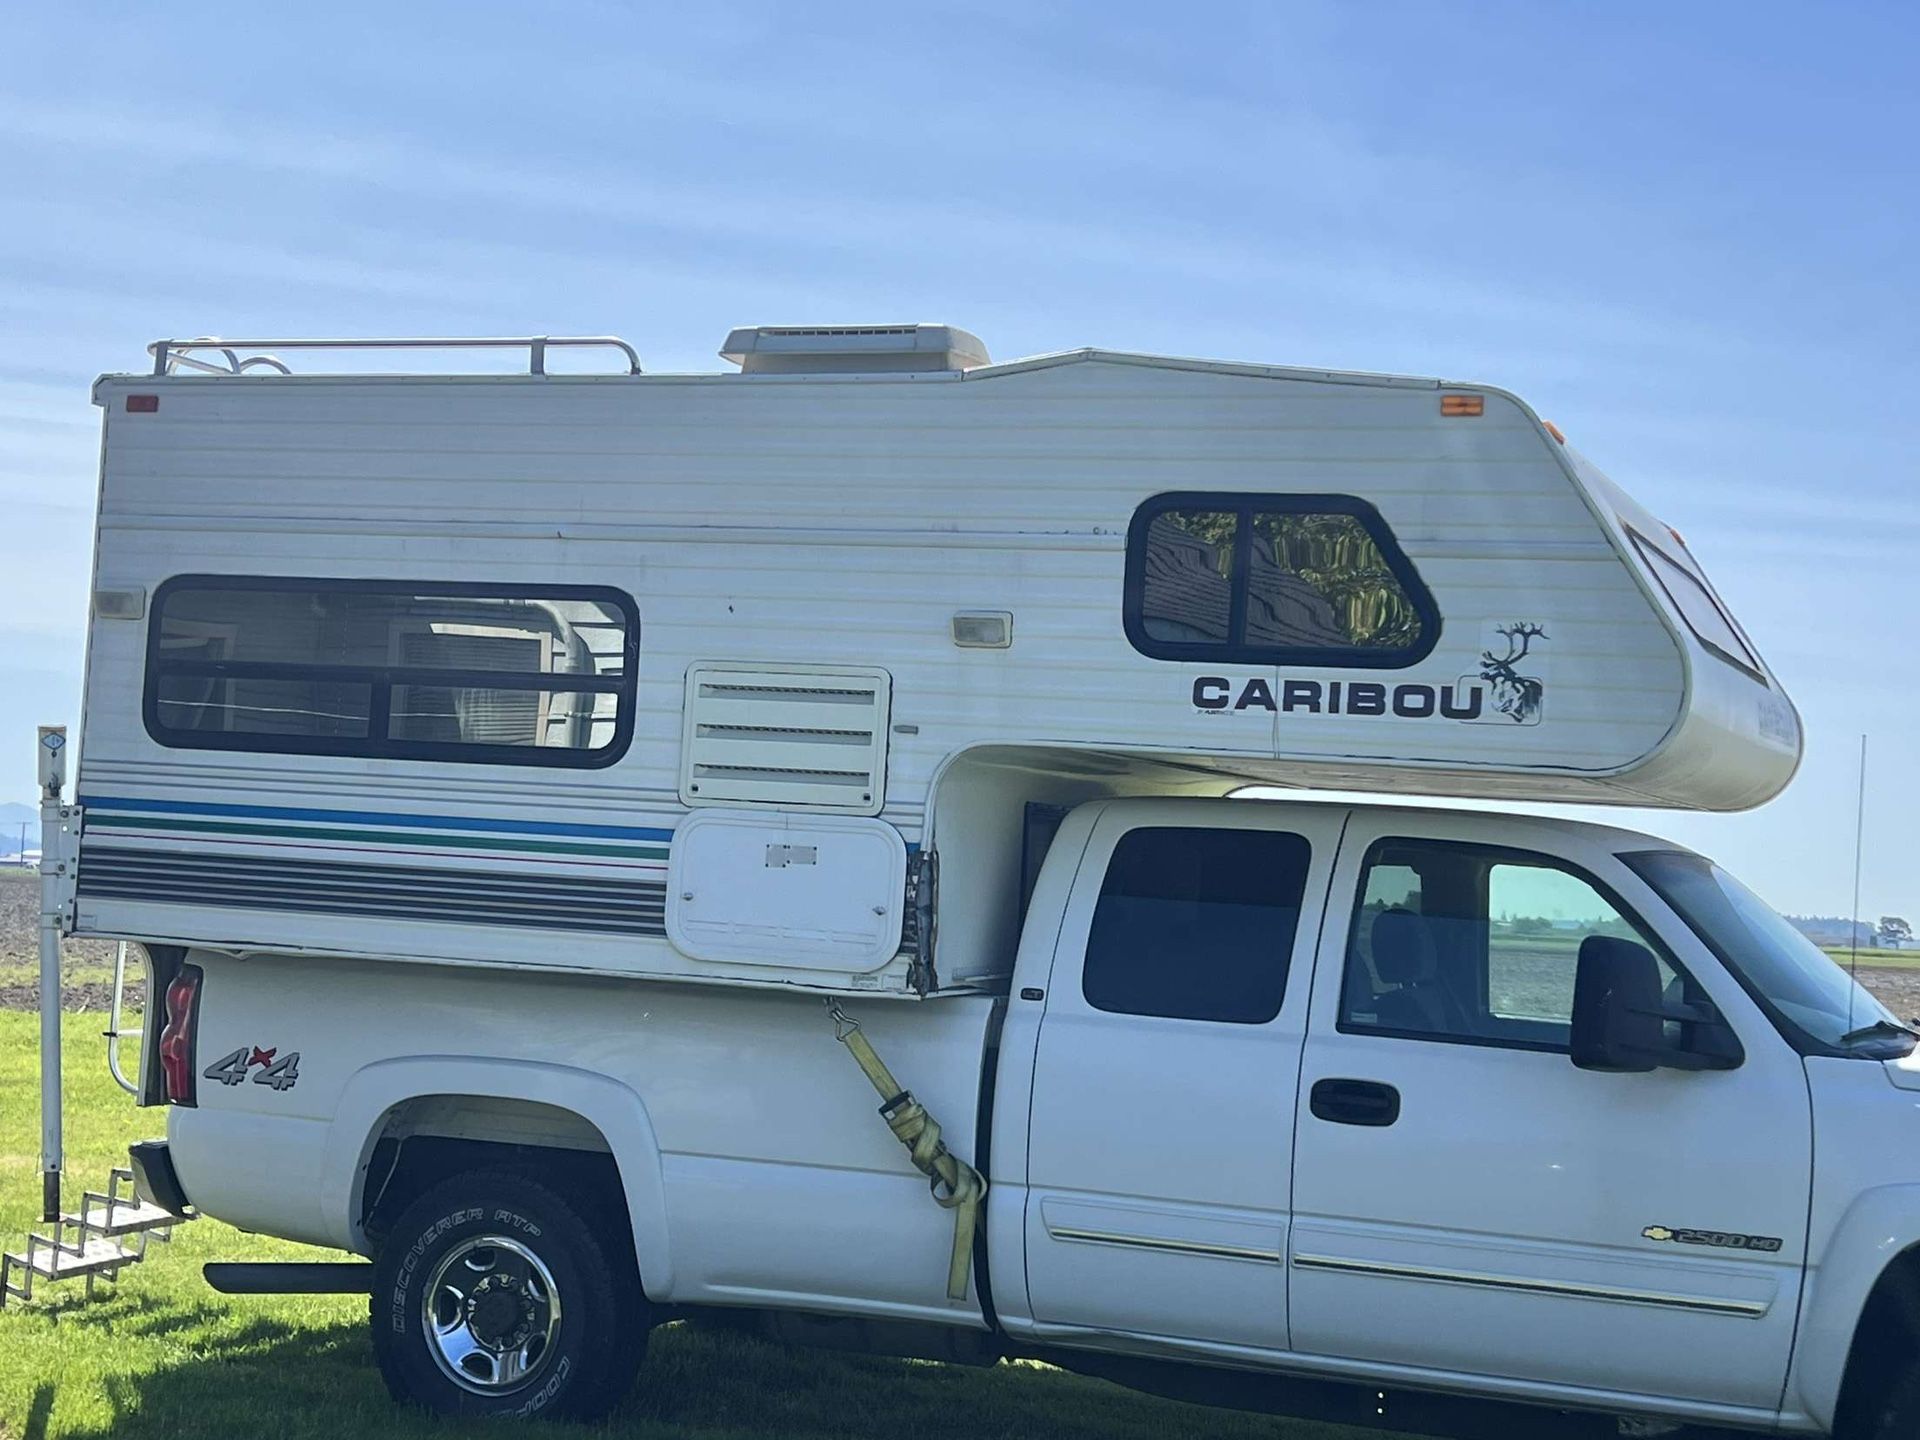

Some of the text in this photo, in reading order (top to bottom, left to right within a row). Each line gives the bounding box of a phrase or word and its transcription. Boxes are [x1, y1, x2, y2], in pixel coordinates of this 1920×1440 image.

[1192, 676, 1483, 720] CARIBOU
[1677, 1229, 1782, 1252] 2500 HD
[391, 1208, 542, 1333] DISCOVERER ATP
